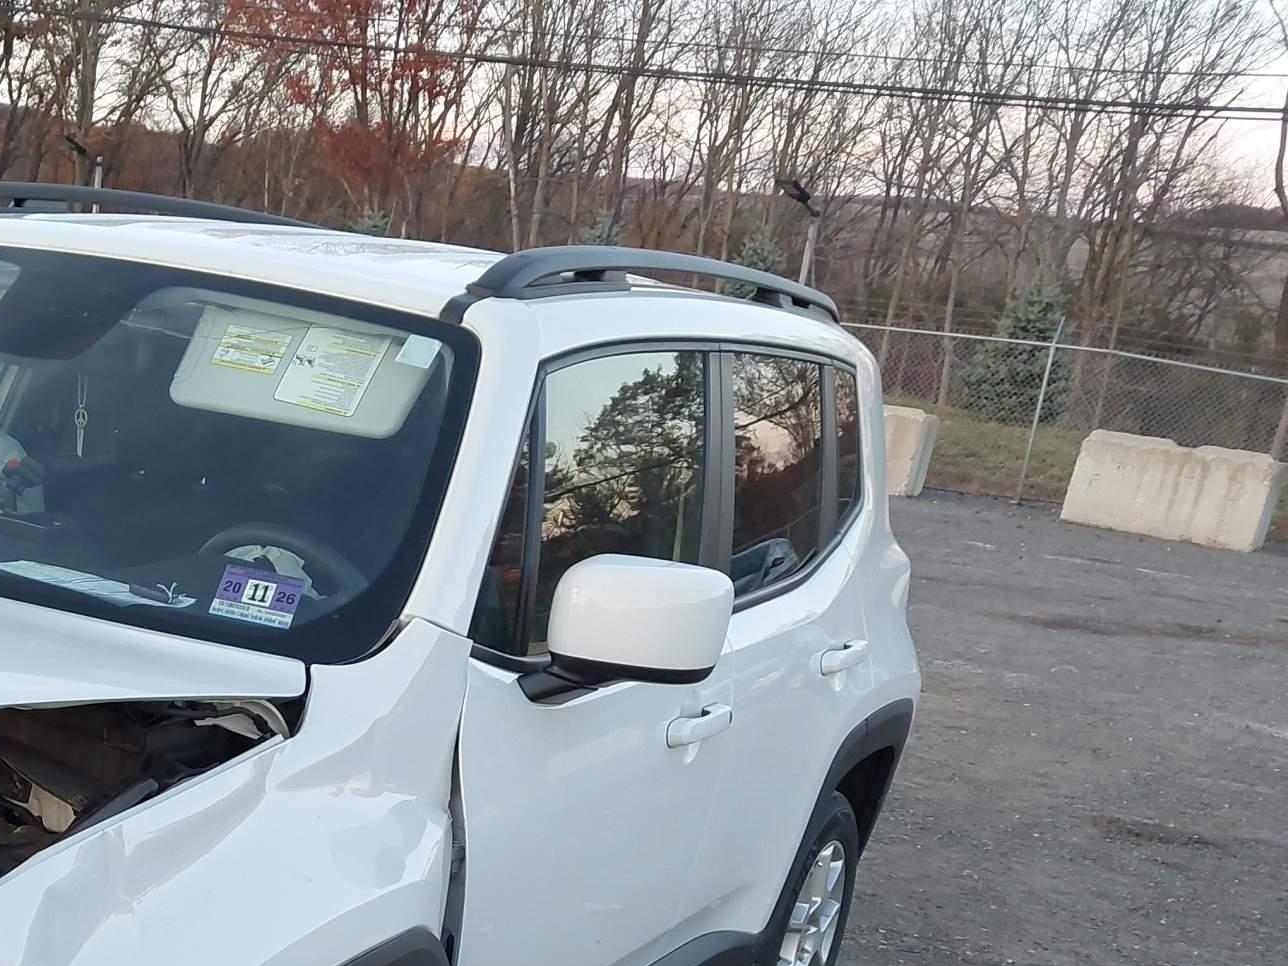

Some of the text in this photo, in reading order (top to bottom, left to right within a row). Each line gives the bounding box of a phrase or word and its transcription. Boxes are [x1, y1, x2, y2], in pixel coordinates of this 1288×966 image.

[223, 580, 297, 605] 20 11 26
